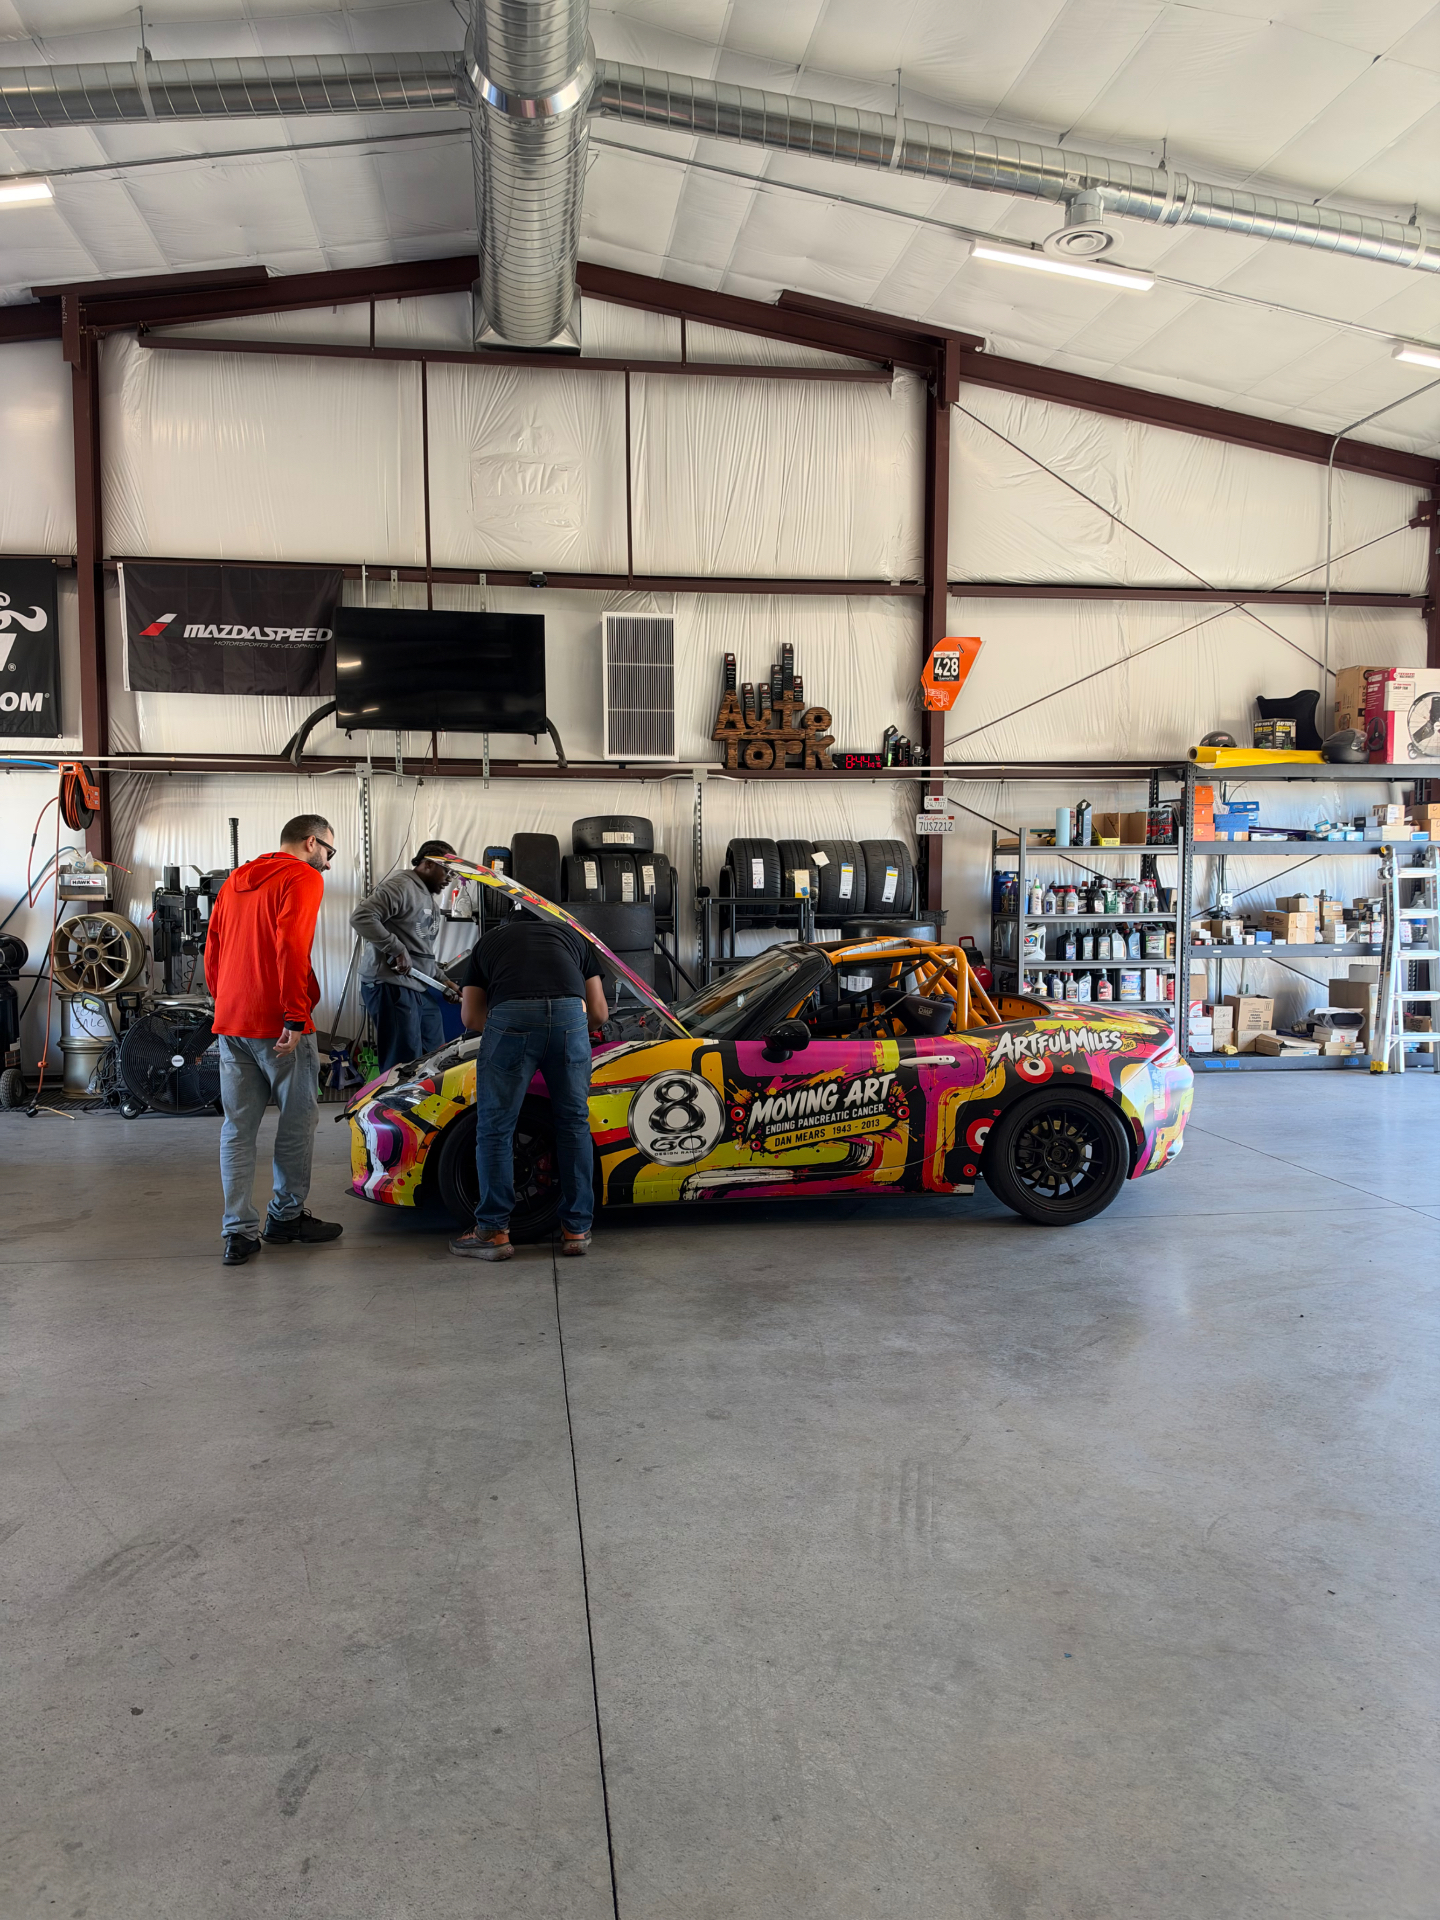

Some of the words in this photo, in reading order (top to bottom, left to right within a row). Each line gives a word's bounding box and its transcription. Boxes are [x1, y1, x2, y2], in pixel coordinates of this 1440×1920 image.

[183, 624, 333, 642] MAZDASPEED
[213, 640, 268, 648] MOTORSPORTS
[934, 658, 959, 676] 428
[845, 754, 870, 769] 8:44
[918, 821, 953, 831] 7USZ212
[614, 860, 631, 875] 40
[917, 1006, 933, 1016] OMP
[71, 1018, 105, 1029] SALE
[648, 1078, 706, 1134] 8
[746, 1083, 840, 1138] MOVING
[844, 1073, 897, 1108] ART
[765, 1121, 796, 1135] ENDING
[798, 1110, 850, 1128] PANCREATIC
[852, 1103, 887, 1118] CANCER.
[774, 1136, 792, 1148] DAN
[795, 1128, 826, 1144] MEARS
[832, 1125, 852, 1135] 1943
[861, 1118, 880, 1130] 2013
